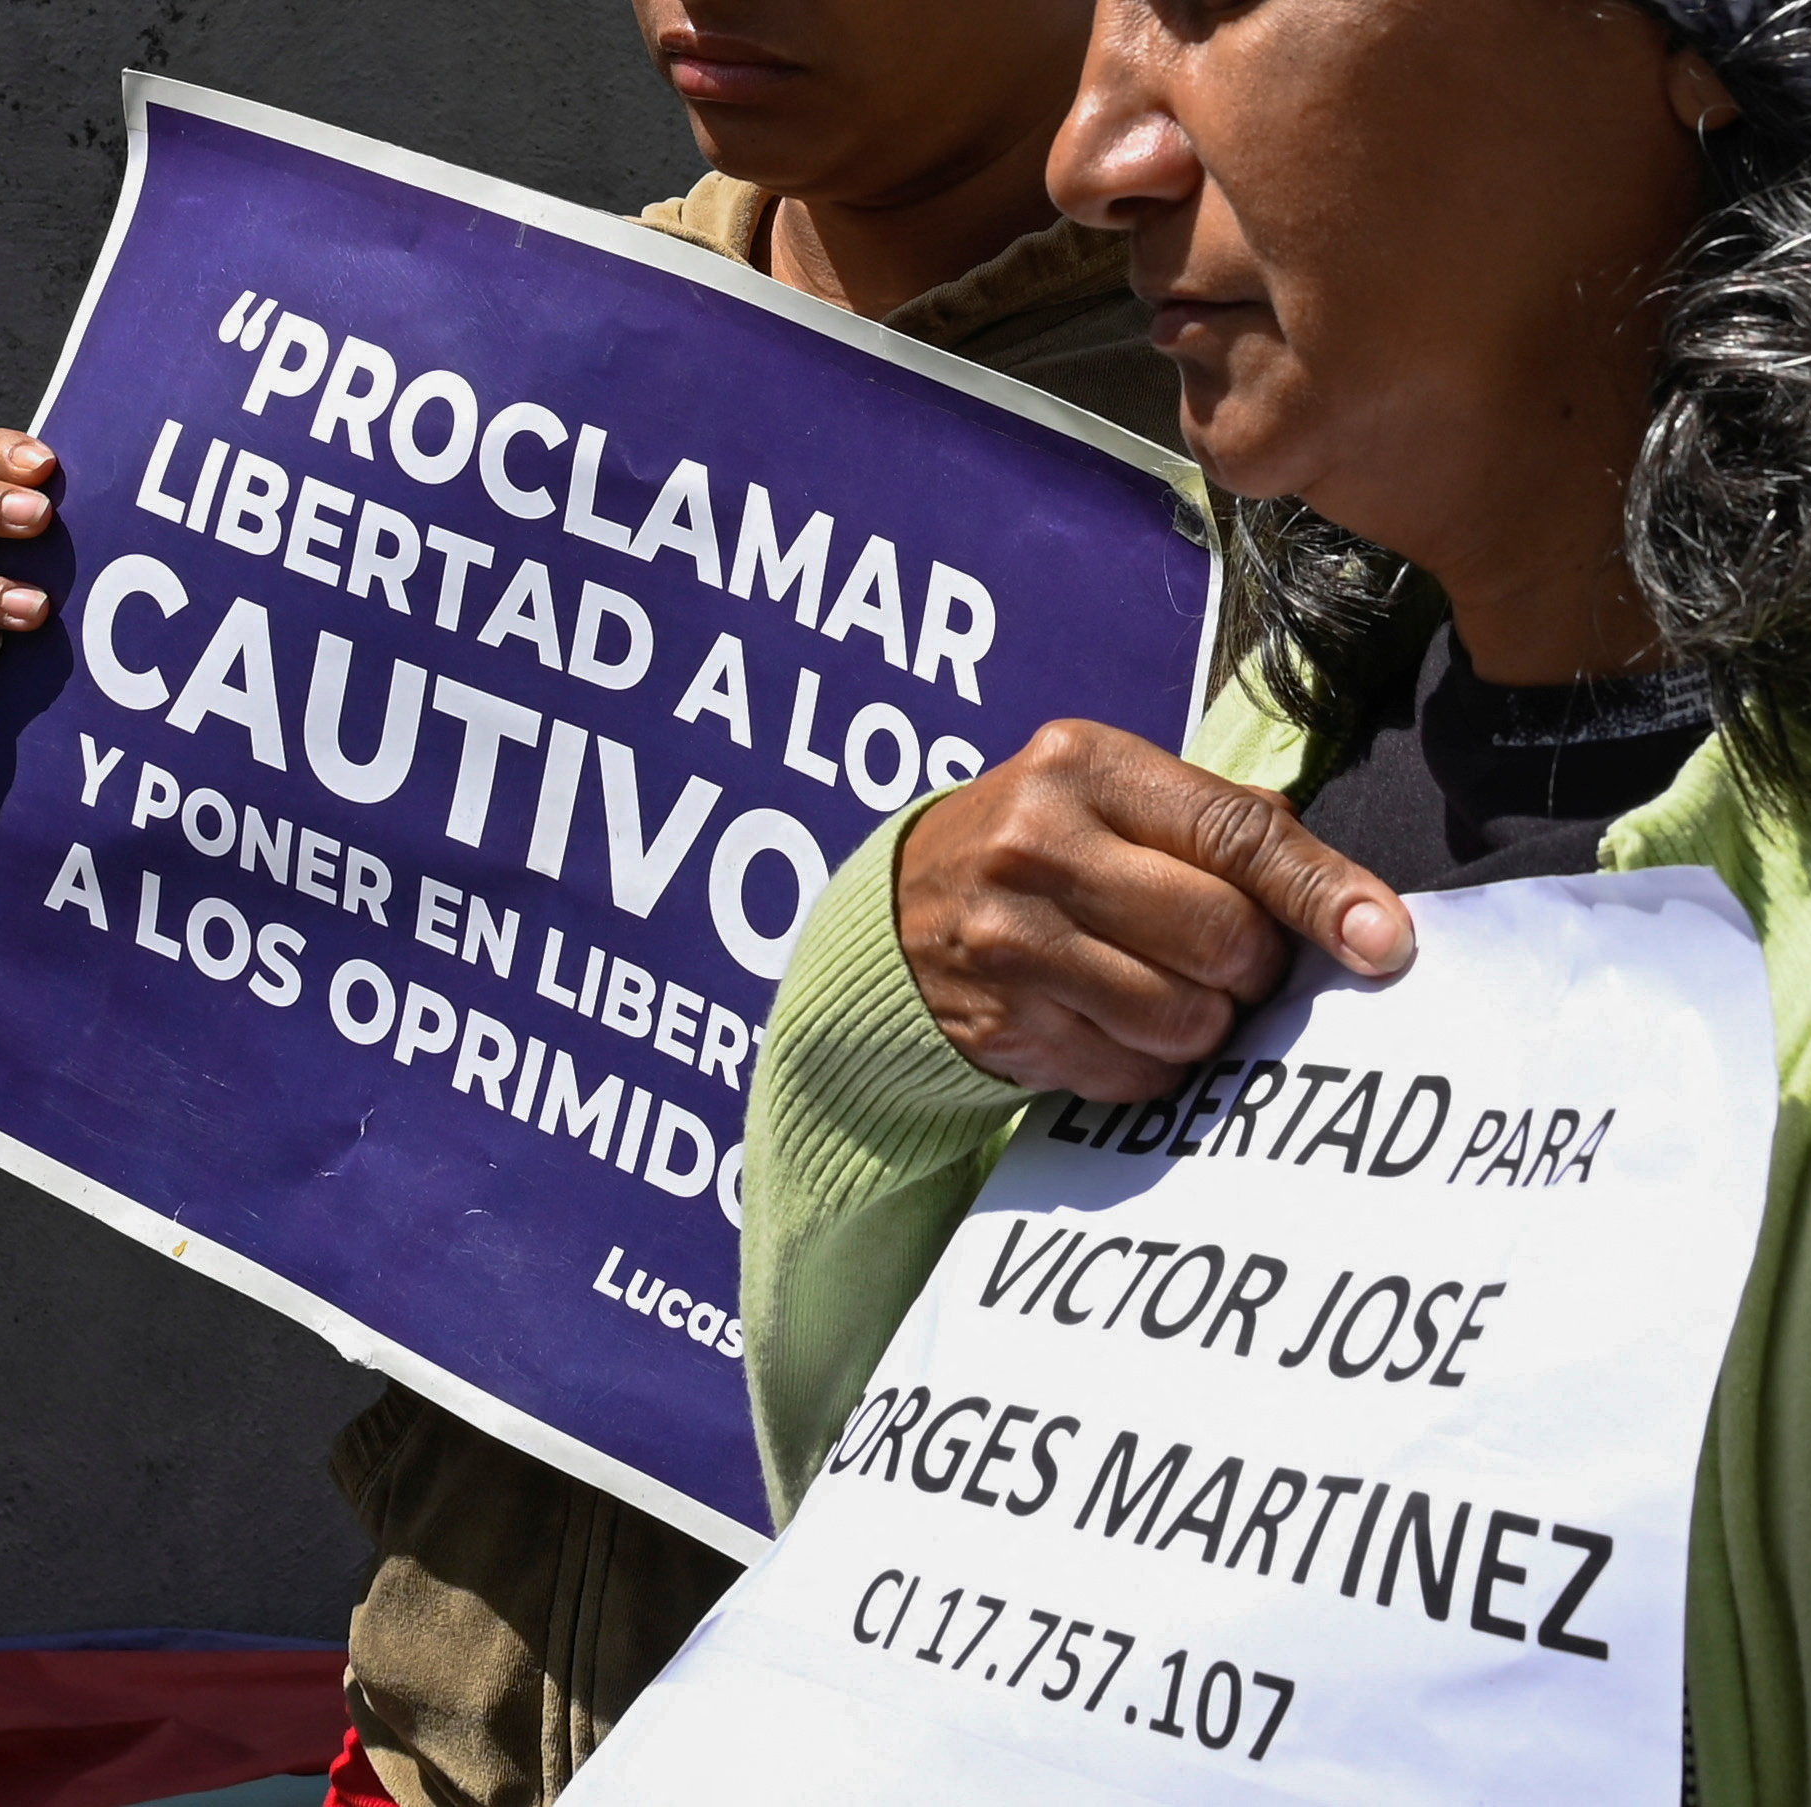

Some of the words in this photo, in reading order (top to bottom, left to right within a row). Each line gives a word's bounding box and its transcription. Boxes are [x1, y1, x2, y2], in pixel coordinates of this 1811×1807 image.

[135, 418, 654, 691] LIBERTAD
[673, 631, 752, 749] A
[217, 289, 996, 706] “PROCLAMAR
[43, 842, 109, 931] A
[135, 871, 307, 1008] LOS
[79, 732, 125, 808] Y
[132, 761, 392, 927] PONER
[414, 875, 521, 979] EN
[536, 927, 765, 1091] LIBER
[1447, 1108, 1616, 1187] PARA
[592, 1245, 745, 1359] Lucas
[979, 1218, 1288, 1357] VICTOR
[1278, 1270, 1507, 1388] JOSE
[825, 1385, 1081, 1517] ORGES
[1073, 1430, 1614, 1662] MARTINEZ
[853, 1569, 921, 1650] CI
[915, 1588, 1296, 1762] 17.757.107
